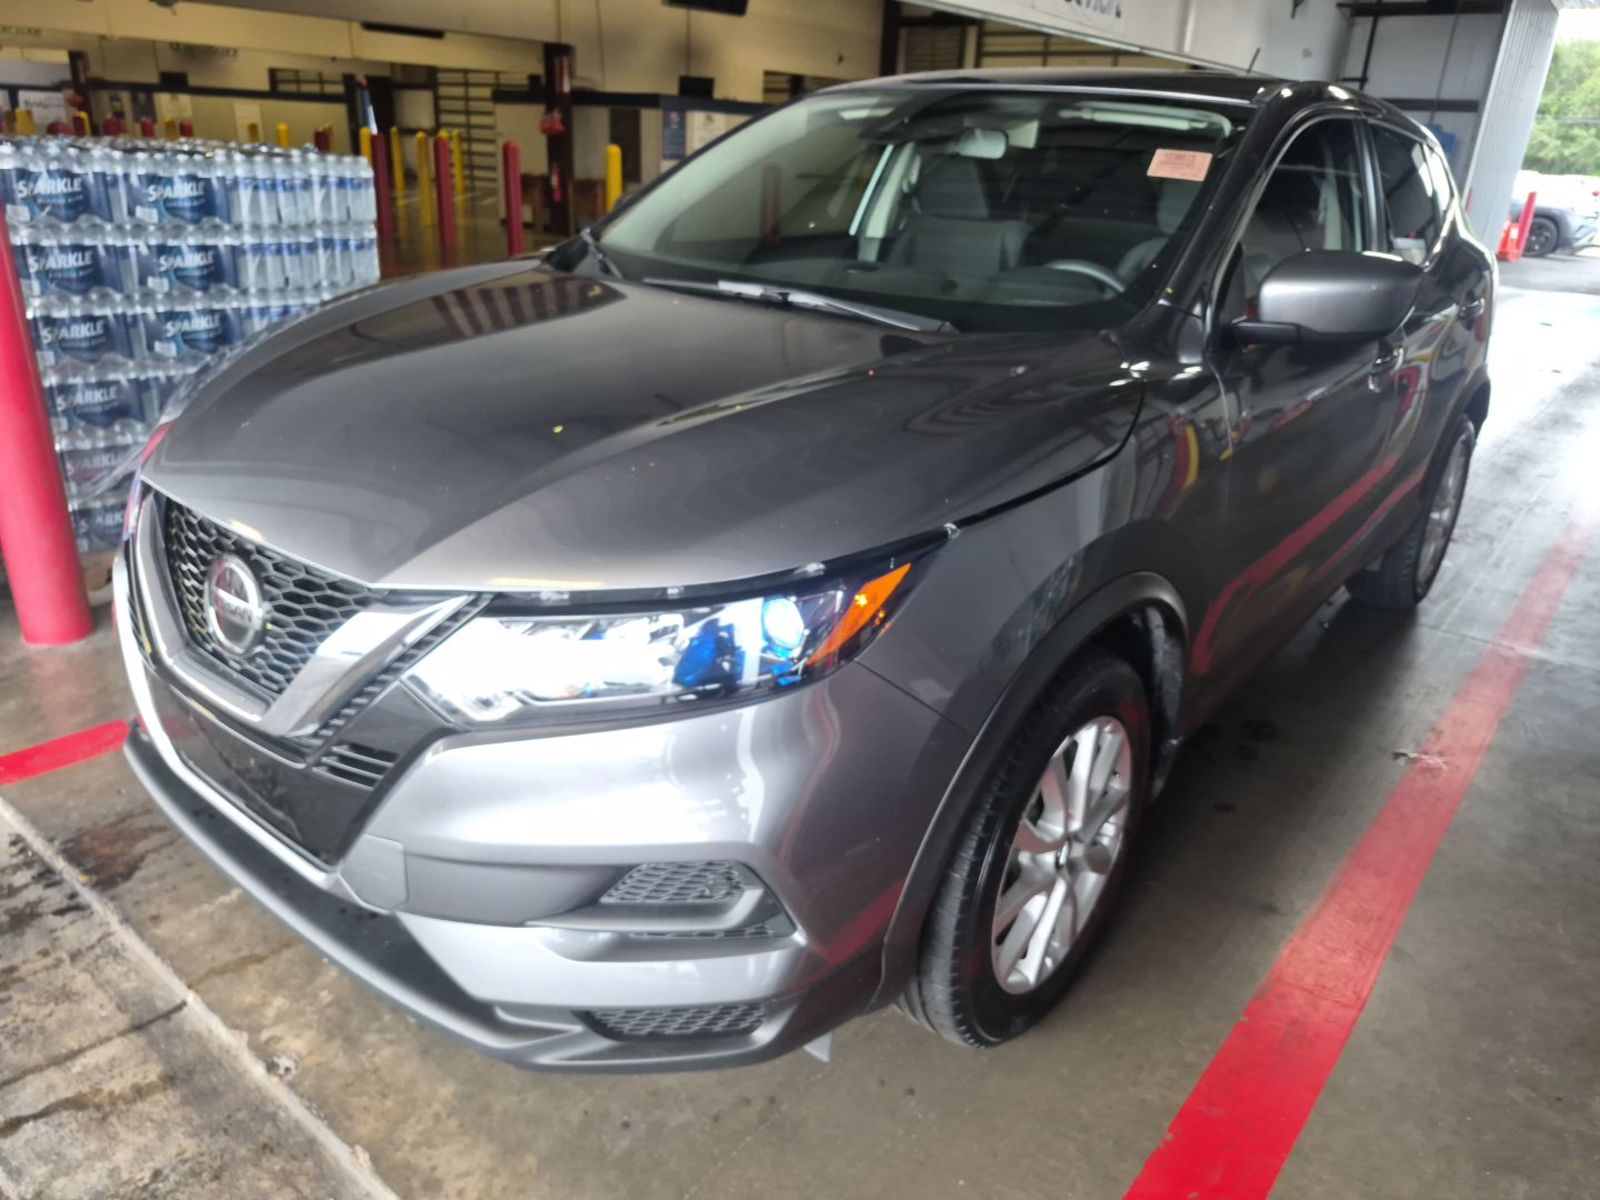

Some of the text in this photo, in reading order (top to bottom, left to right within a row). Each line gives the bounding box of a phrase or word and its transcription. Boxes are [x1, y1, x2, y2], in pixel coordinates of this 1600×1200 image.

[18, 176, 82, 199] SPARKLE
[147, 180, 205, 202] SPARKLE
[28, 251, 93, 273] SPARKLE
